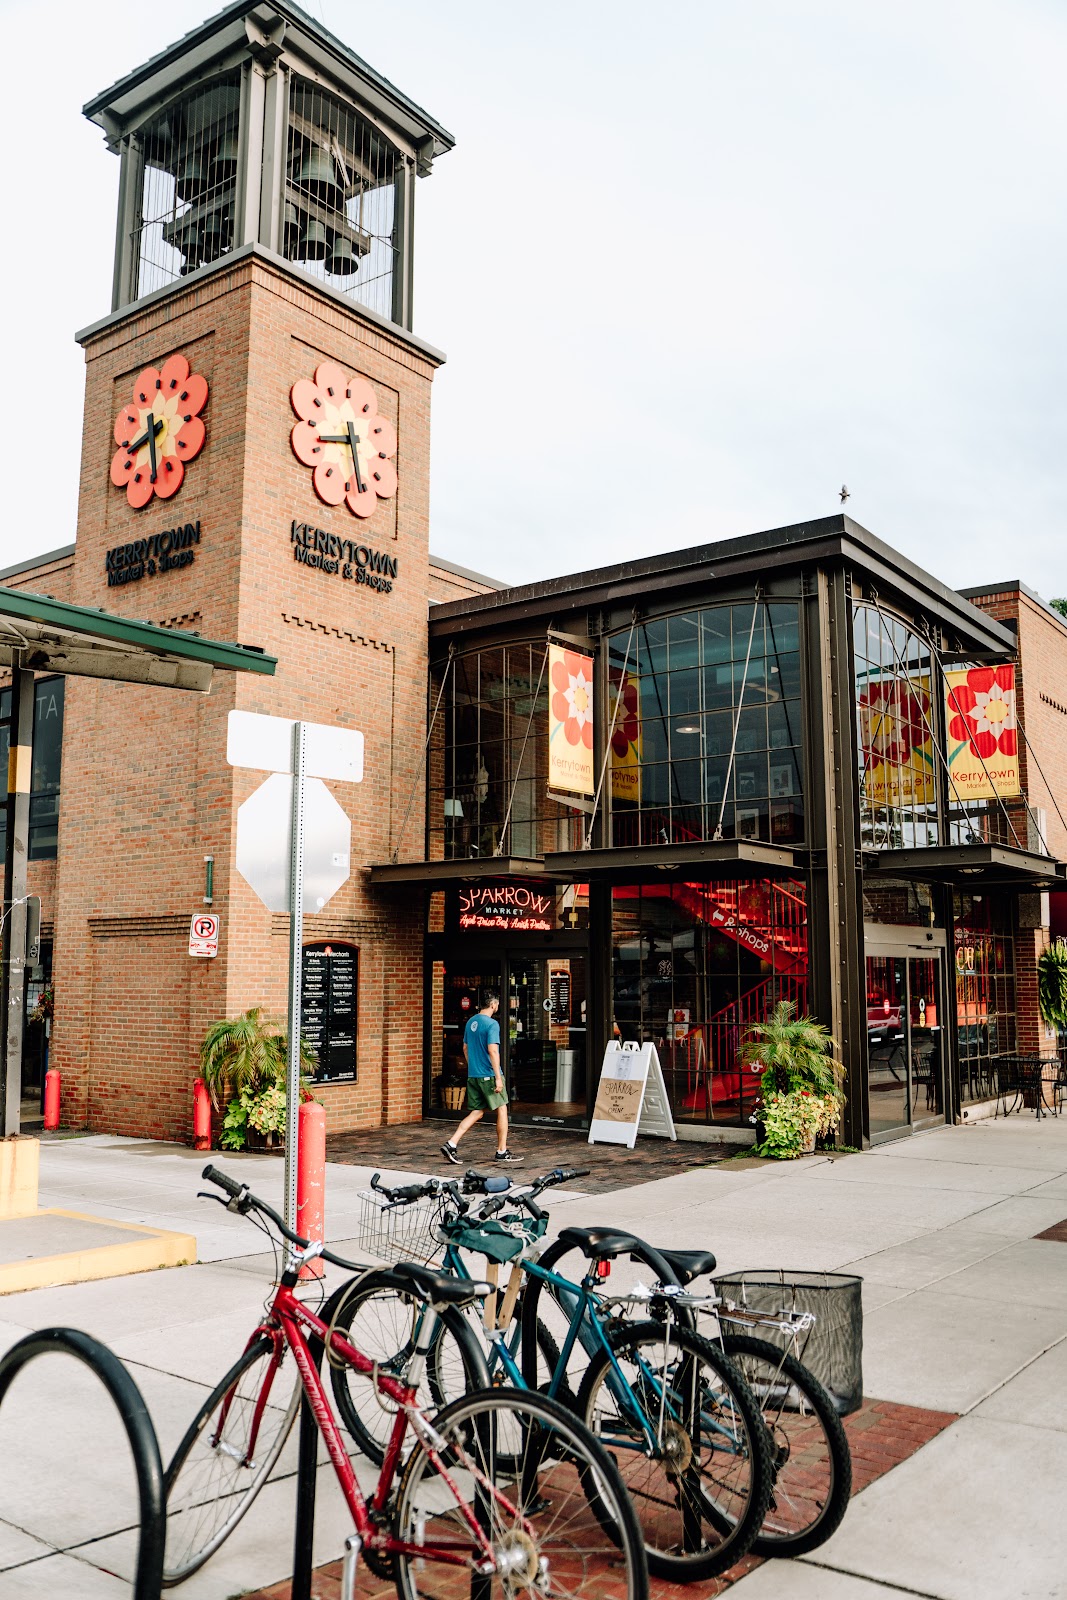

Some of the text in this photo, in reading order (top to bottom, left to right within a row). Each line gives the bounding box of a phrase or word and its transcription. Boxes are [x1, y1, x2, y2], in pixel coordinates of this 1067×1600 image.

[106, 520, 200, 571] KERRYTOWN
[291, 520, 398, 579] KERRYTOWN
[107, 549, 194, 587] Market & Shops
[294, 544, 393, 594] Market & Shops
[552, 755, 591, 774] Kerrytown
[952, 769, 1015, 782] Kerrytown
[966, 780, 1016, 790] Market Shops
[459, 887, 551, 914] SPARROW
[485, 906, 524, 916] MARKET
